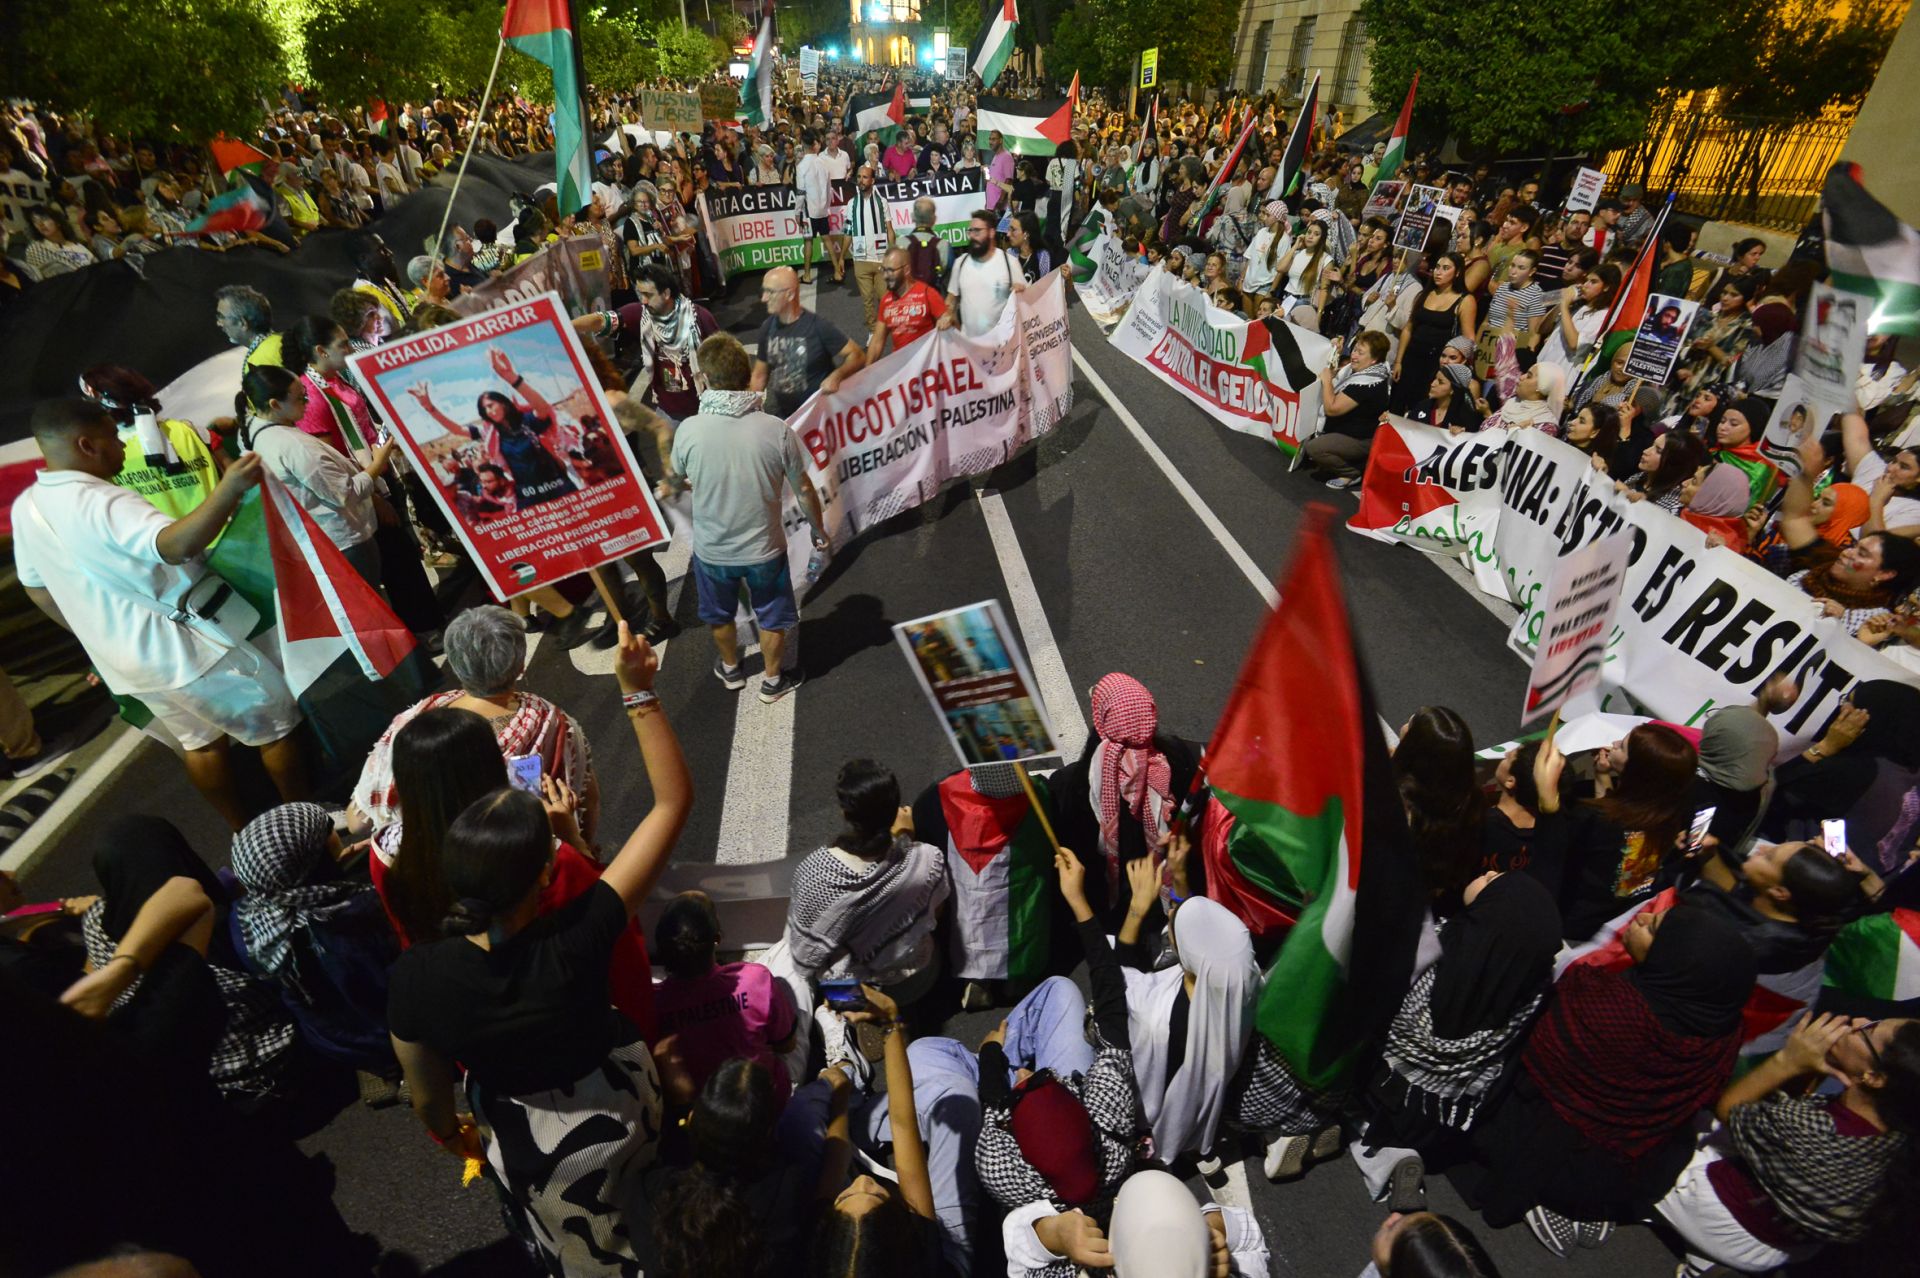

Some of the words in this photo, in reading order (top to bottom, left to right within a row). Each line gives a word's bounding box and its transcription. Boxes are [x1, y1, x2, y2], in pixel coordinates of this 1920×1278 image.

[655, 106, 697, 122] LIBRE
[708, 190, 797, 218] ARTAGENA
[732, 220, 775, 242] LIBRE
[1168, 296, 1180, 328] LA
[375, 334, 458, 369] KHALIDA
[465, 306, 538, 341] JARRAR
[1155, 332, 1198, 387] CONTRA
[1200, 360, 1217, 399] EL
[801, 388, 897, 471] BOICOT
[898, 357, 984, 418] ISRAEL
[838, 424, 929, 484] LIBERACIÓN
[940, 388, 1017, 430] PALESTINA
[521, 486, 536, 498] 60
[538, 477, 564, 494] años
[521, 508, 536, 519] de
[535, 502, 548, 513] la
[547, 494, 577, 511] lucha
[579, 476, 627, 500] palestina
[1404, 440, 1560, 526] ALESINA:
[490, 529, 508, 541] En
[507, 523, 525, 535] las
[494, 532, 564, 564] LIBERACIÓN
[563, 504, 641, 540] PRISIONER@S
[515, 521, 559, 541] muchas
[558, 509, 591, 527] veces
[542, 529, 610, 561] PALESTINAS
[1632, 544, 1696, 623] ES
[1662, 577, 1863, 743] RESISTI
